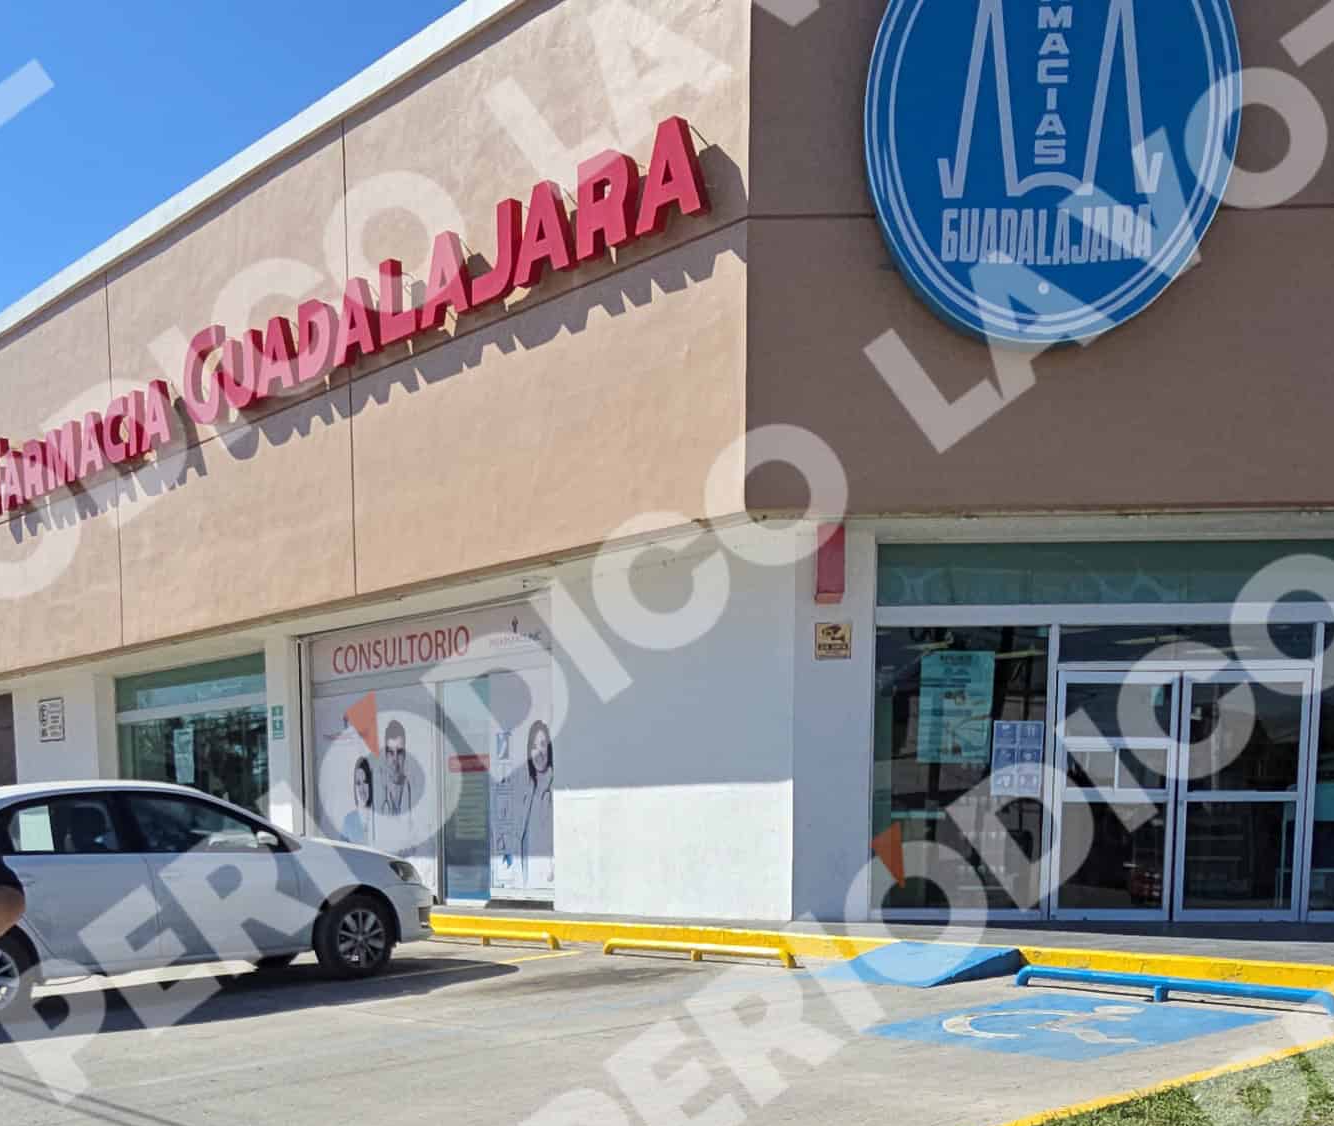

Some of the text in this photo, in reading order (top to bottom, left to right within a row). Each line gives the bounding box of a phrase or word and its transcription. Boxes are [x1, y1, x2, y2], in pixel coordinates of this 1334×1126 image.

[1034, 0, 1073, 165] MACIAS
[183, 115, 710, 425] GUADALAJARA
[940, 204, 1152, 265] GUADALAJARA
[332, 625, 471, 675] CONSULTORIO
